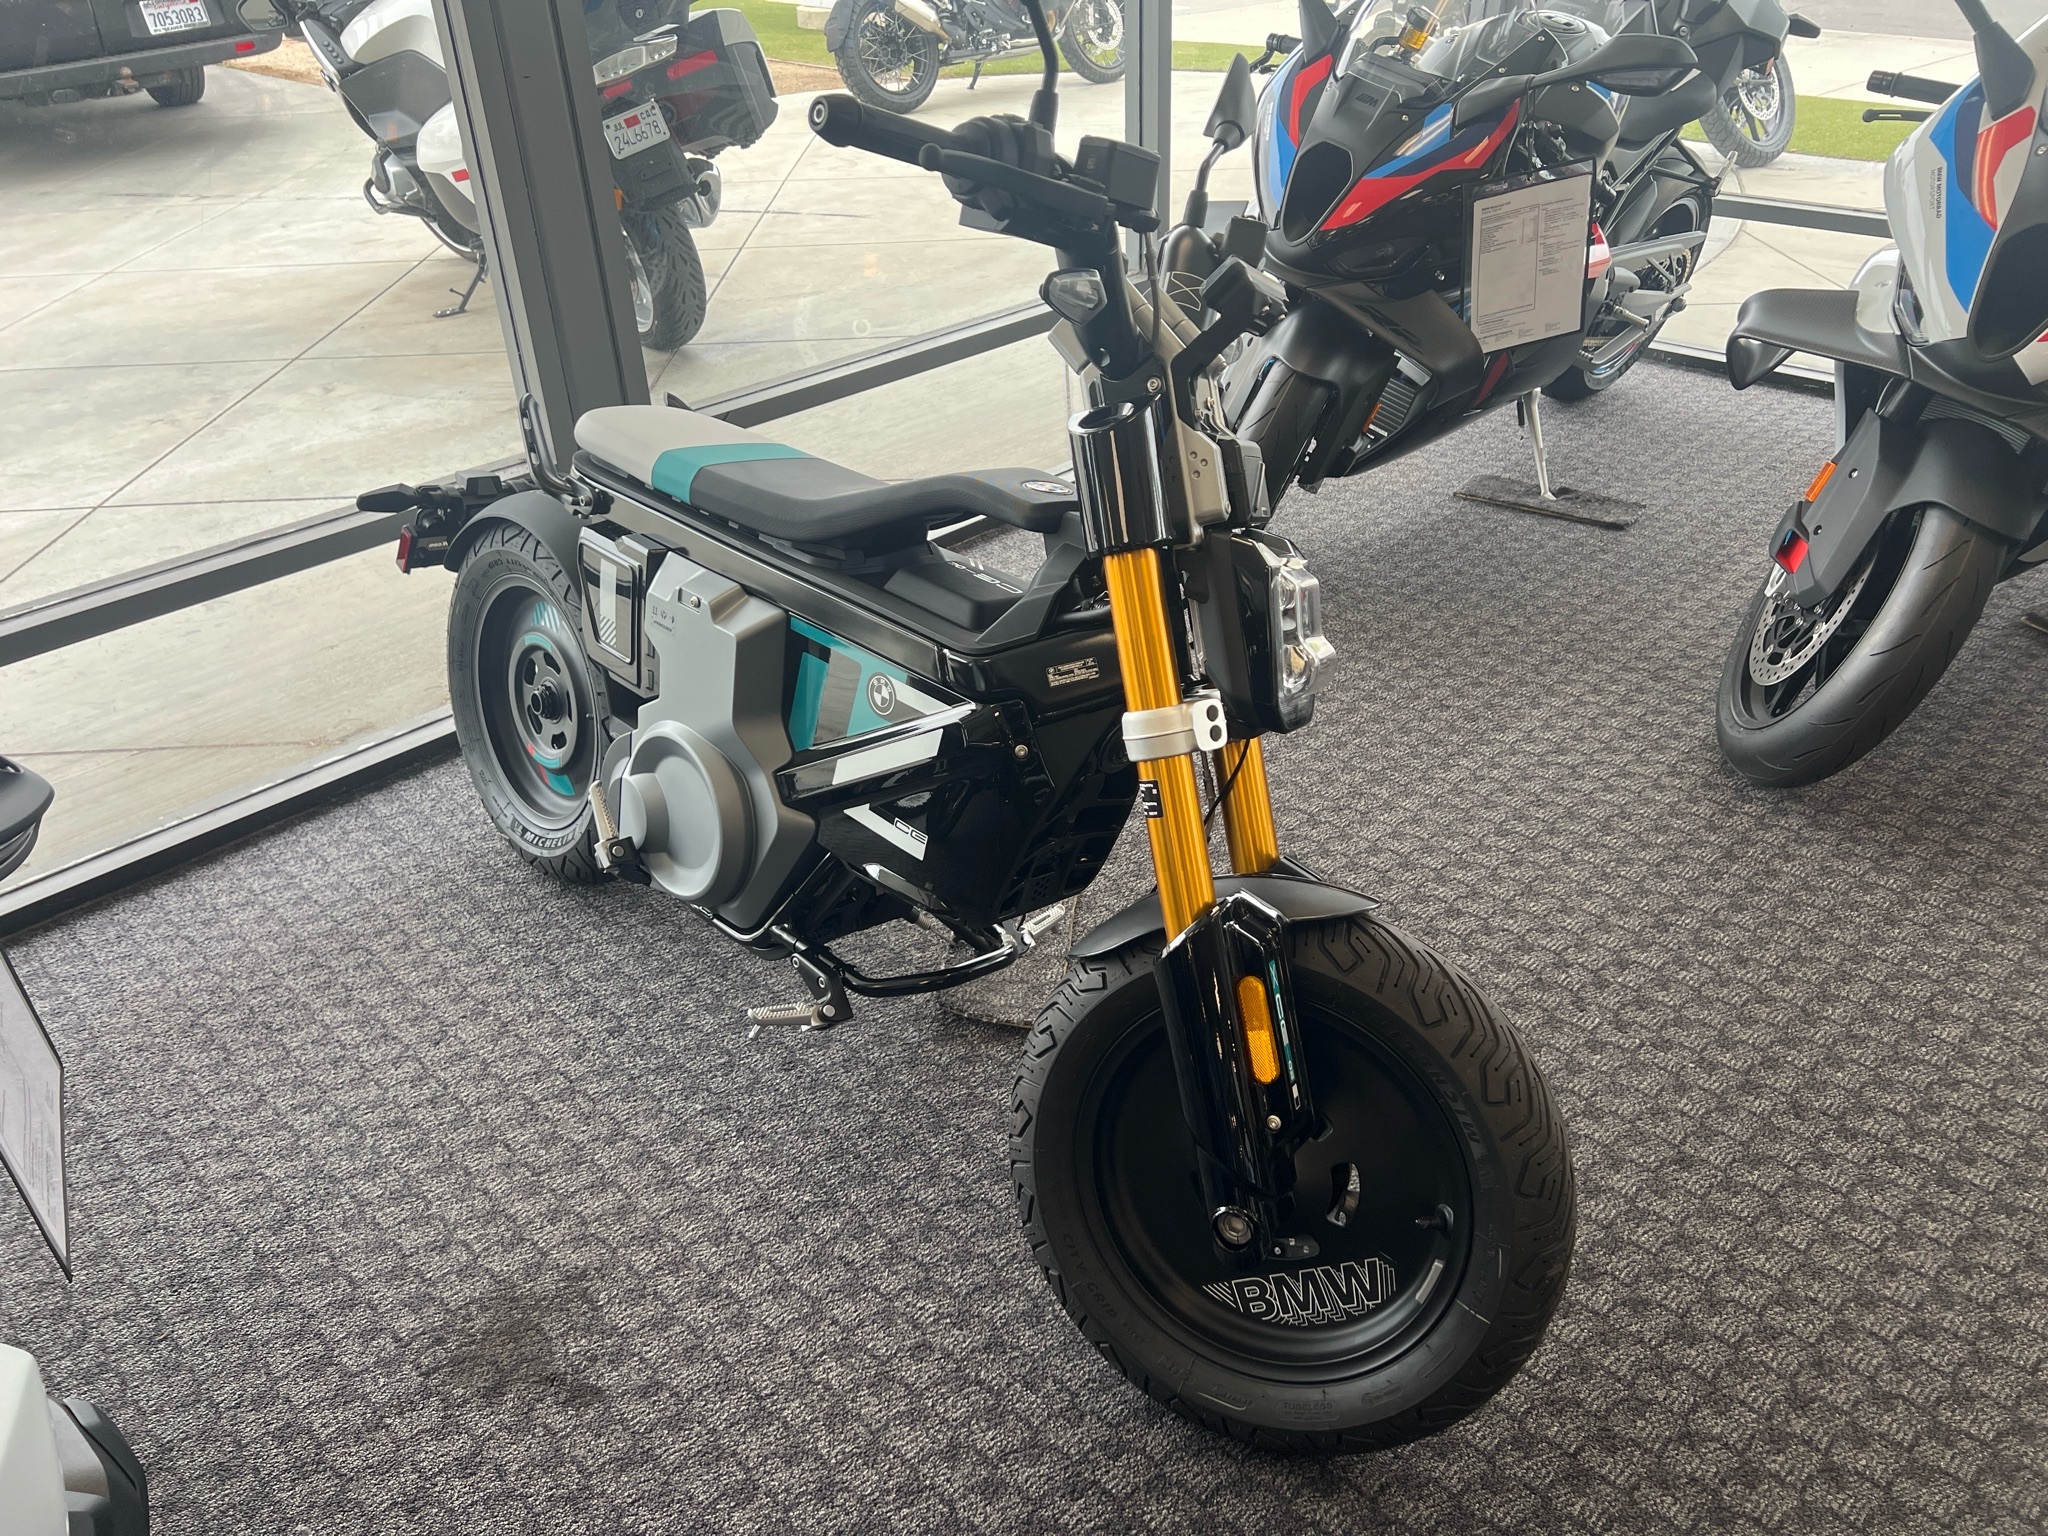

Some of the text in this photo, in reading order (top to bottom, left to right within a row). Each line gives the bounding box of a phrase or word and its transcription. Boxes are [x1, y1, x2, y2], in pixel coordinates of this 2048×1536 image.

[148, 6, 204, 28] 70530B3
[613, 121, 625, 132] JUL
[614, 119, 662, 151] 24L6678
[523, 829, 576, 849] MICHELIN
[1062, 1233, 1088, 1273] CITY
[1087, 1281, 1118, 1319] GRIP
[1231, 1257, 1384, 1323] BMW
[1282, 1401, 1334, 1411] TUBELESS
